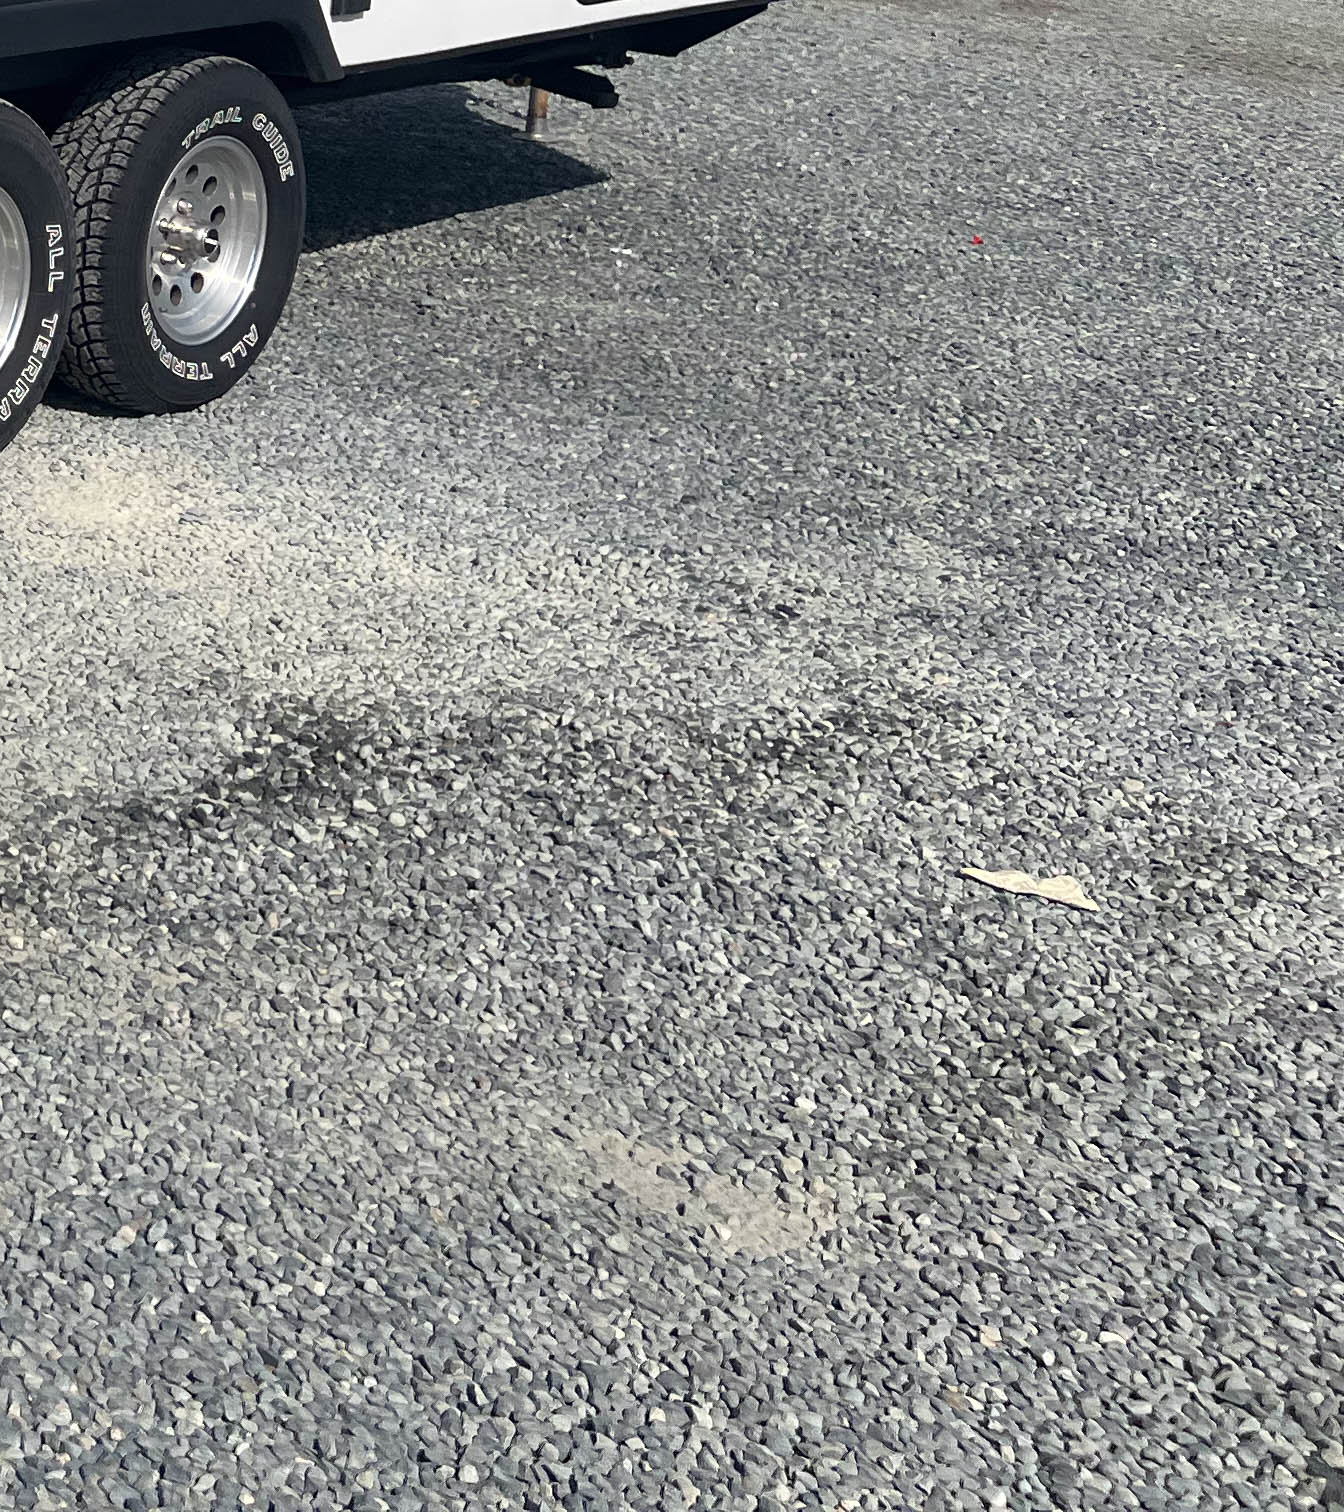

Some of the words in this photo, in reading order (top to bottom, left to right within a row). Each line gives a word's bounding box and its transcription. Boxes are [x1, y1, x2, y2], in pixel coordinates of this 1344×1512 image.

[181, 105, 244, 150] TRAIL
[251, 112, 297, 183] GUIDE
[45, 224, 66, 294] ALL
[141, 302, 214, 381] TERRAIN
[220, 323, 260, 369] ALL
